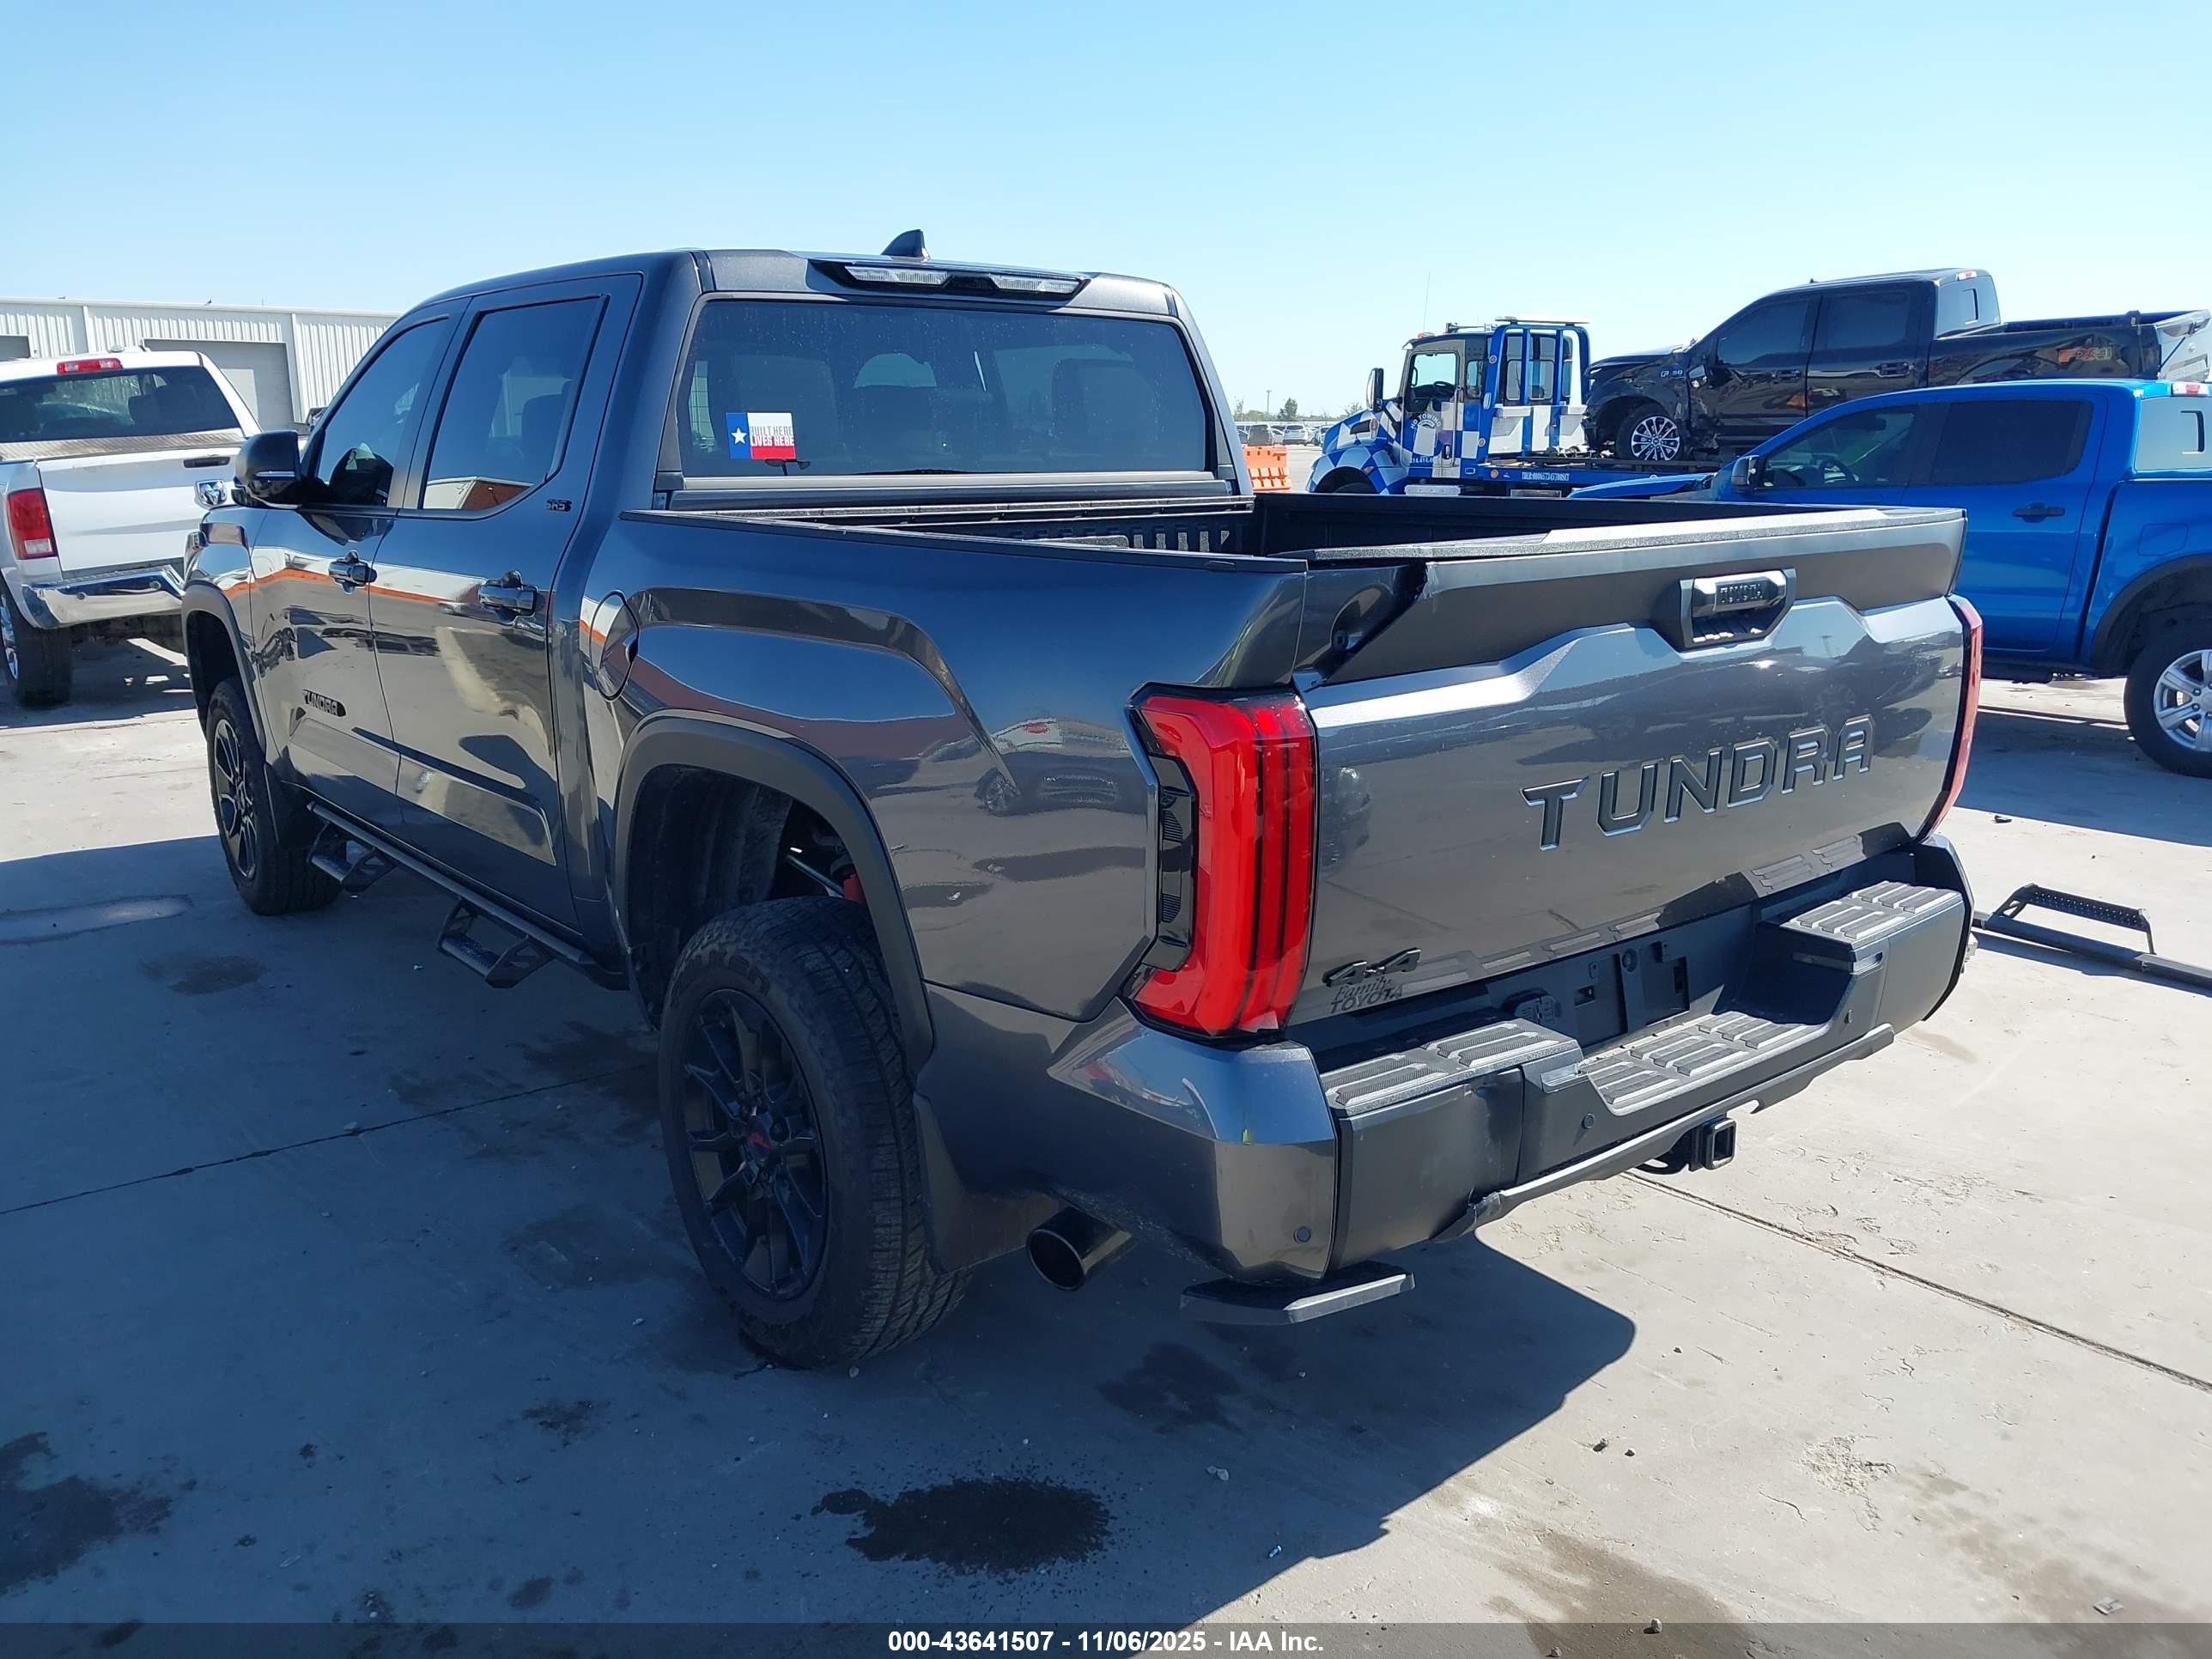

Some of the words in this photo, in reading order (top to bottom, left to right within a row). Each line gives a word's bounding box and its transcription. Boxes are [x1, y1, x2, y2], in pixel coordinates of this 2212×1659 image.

[750, 426, 771, 435] BUILT
[773, 426, 793, 435] HERE
[1419, 413, 1442, 428] TOWING
[751, 435, 773, 447] LIVES
[774, 435, 794, 447] HERE
[1720, 583, 1764, 603] TOYOTA
[302, 689, 339, 716] TUNDRA
[1519, 714, 1875, 851] TUNDRA
[1330, 983, 1404, 1014] TOYOTA
[1334, 976, 1393, 1000] Family
